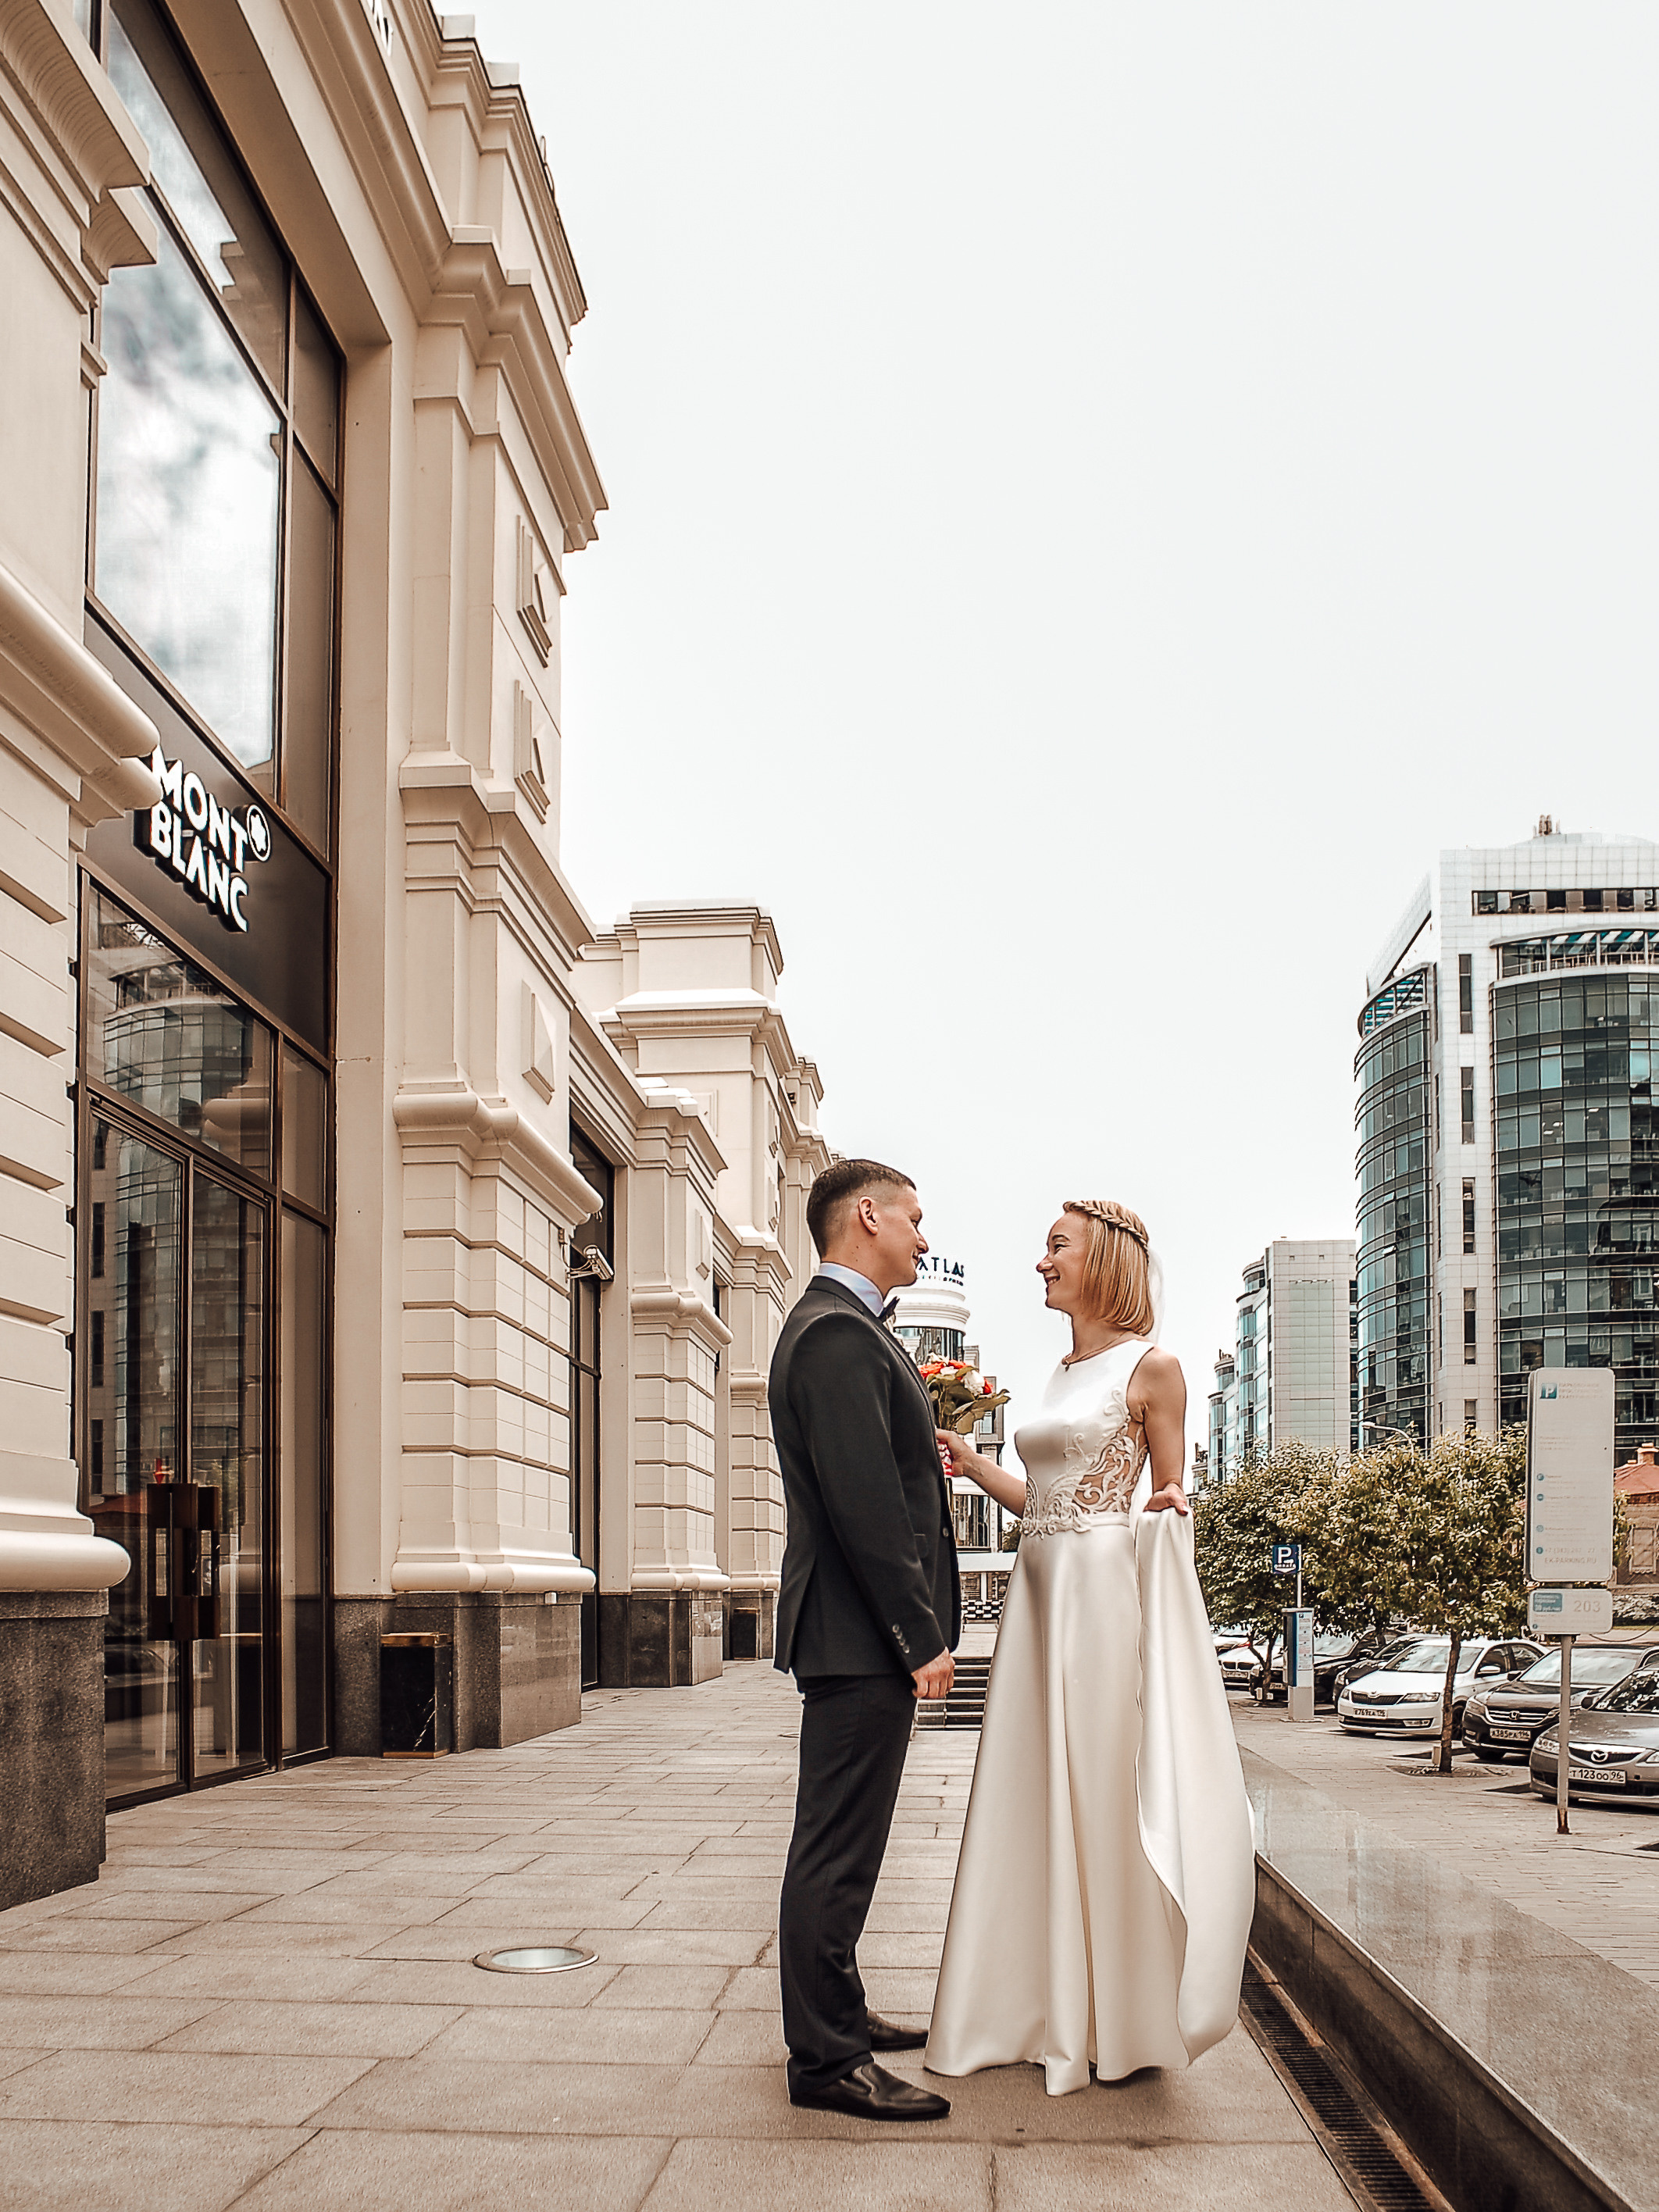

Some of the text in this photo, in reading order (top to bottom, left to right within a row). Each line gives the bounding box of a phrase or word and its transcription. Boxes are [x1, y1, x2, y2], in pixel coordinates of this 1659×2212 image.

[151, 744, 248, 873] MONT
[150, 801, 249, 933] BLANC
[1278, 1547, 1292, 1564] P
[1574, 1600, 1601, 1613] 203
